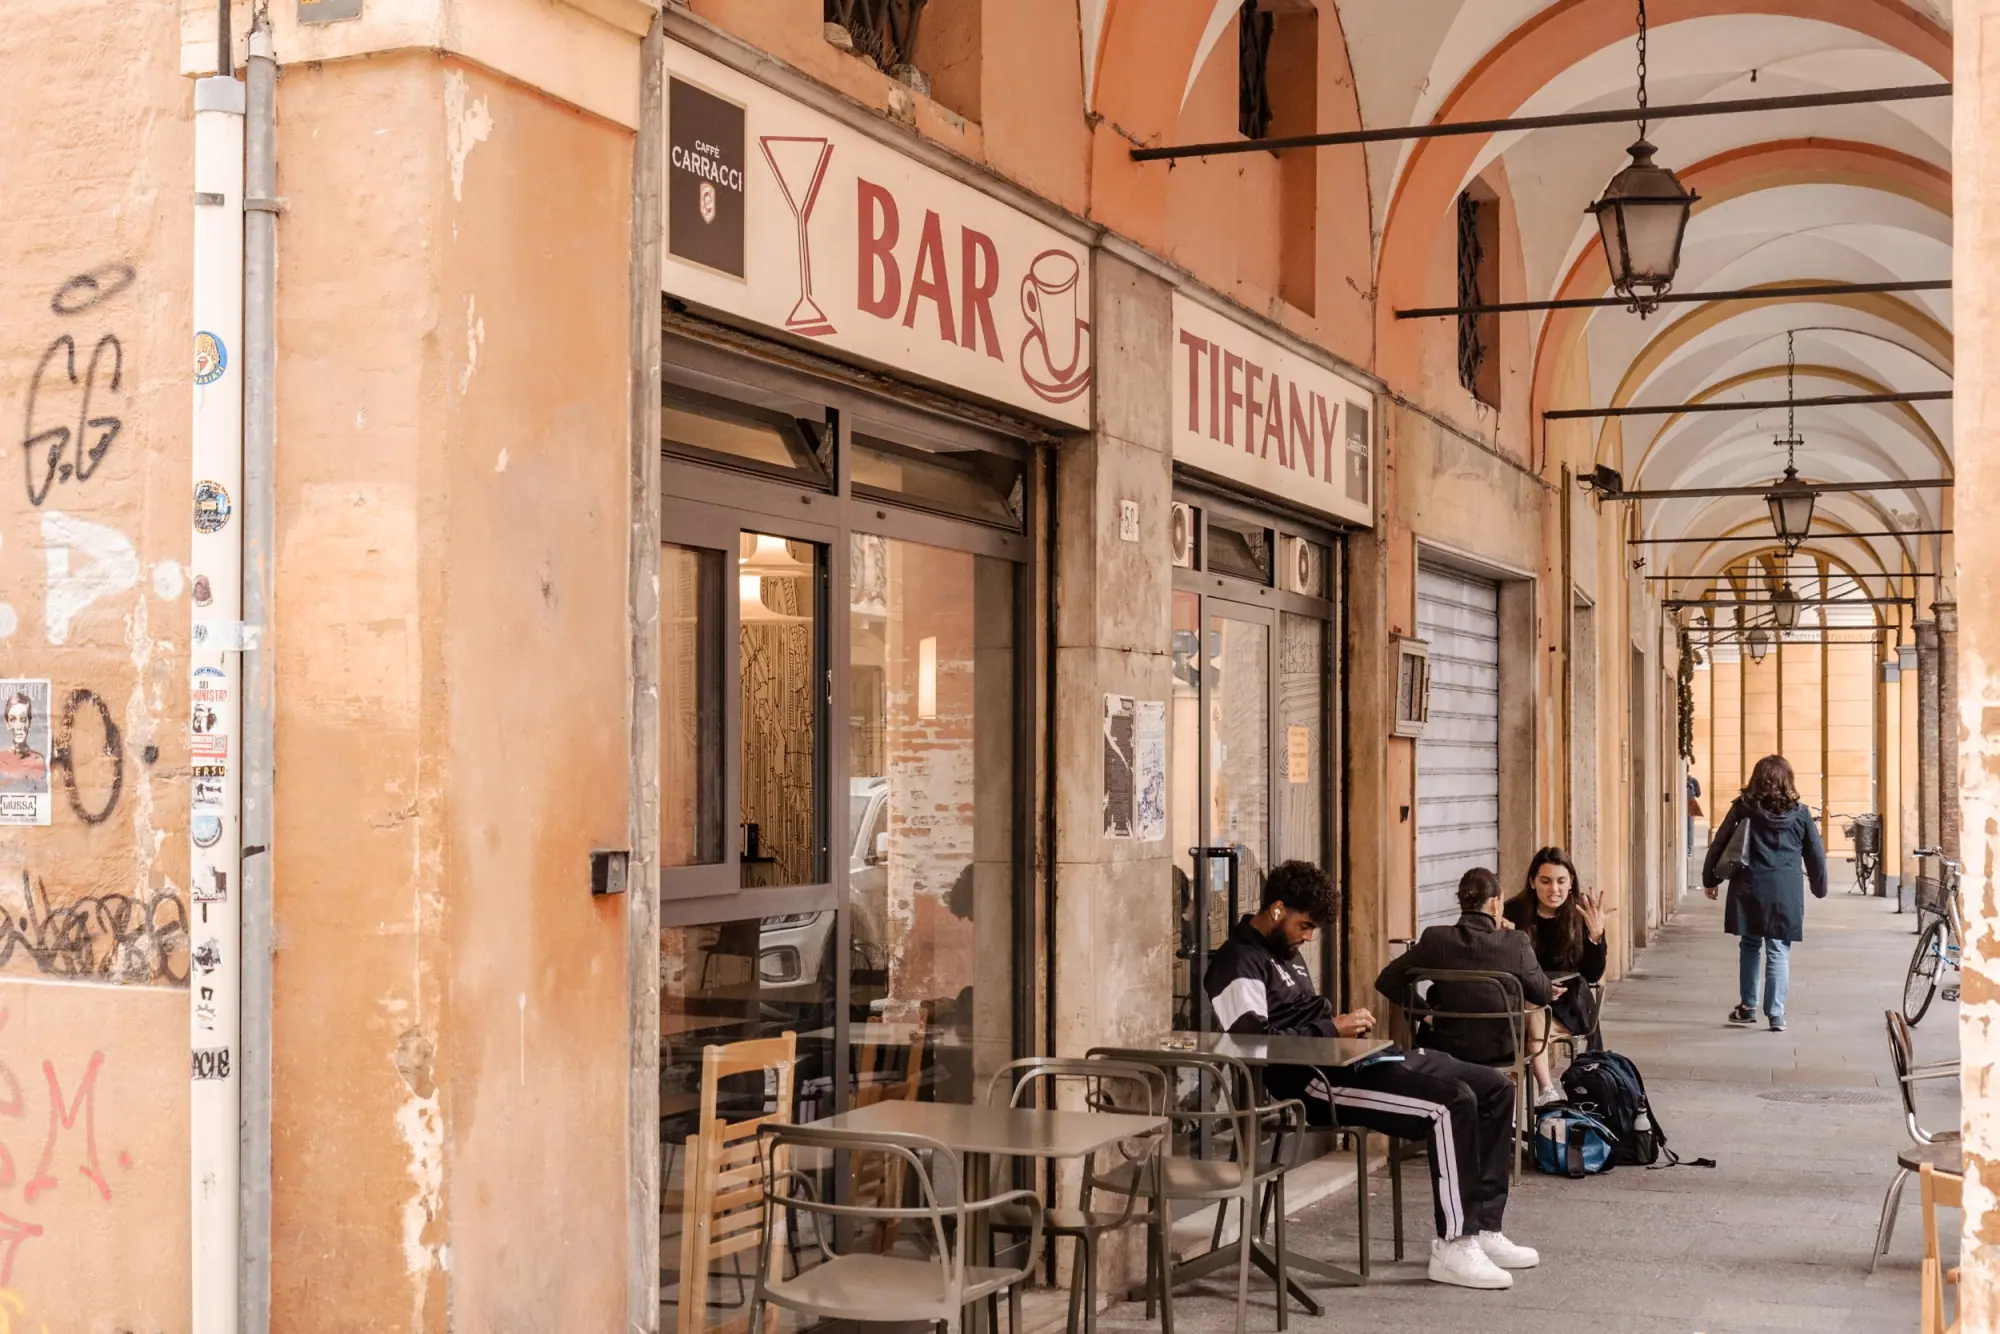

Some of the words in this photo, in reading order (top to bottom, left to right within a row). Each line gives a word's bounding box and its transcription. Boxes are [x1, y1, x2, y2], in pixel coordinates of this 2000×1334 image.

[695, 140, 720, 159] CAFFÈ
[672, 146, 743, 192] CARRACCI
[856, 176, 1005, 364] BAR
[1179, 327, 1340, 486] TIFFANY
[199, 681, 209, 689] SEI
[3, 801, 34, 811] MUSSA
